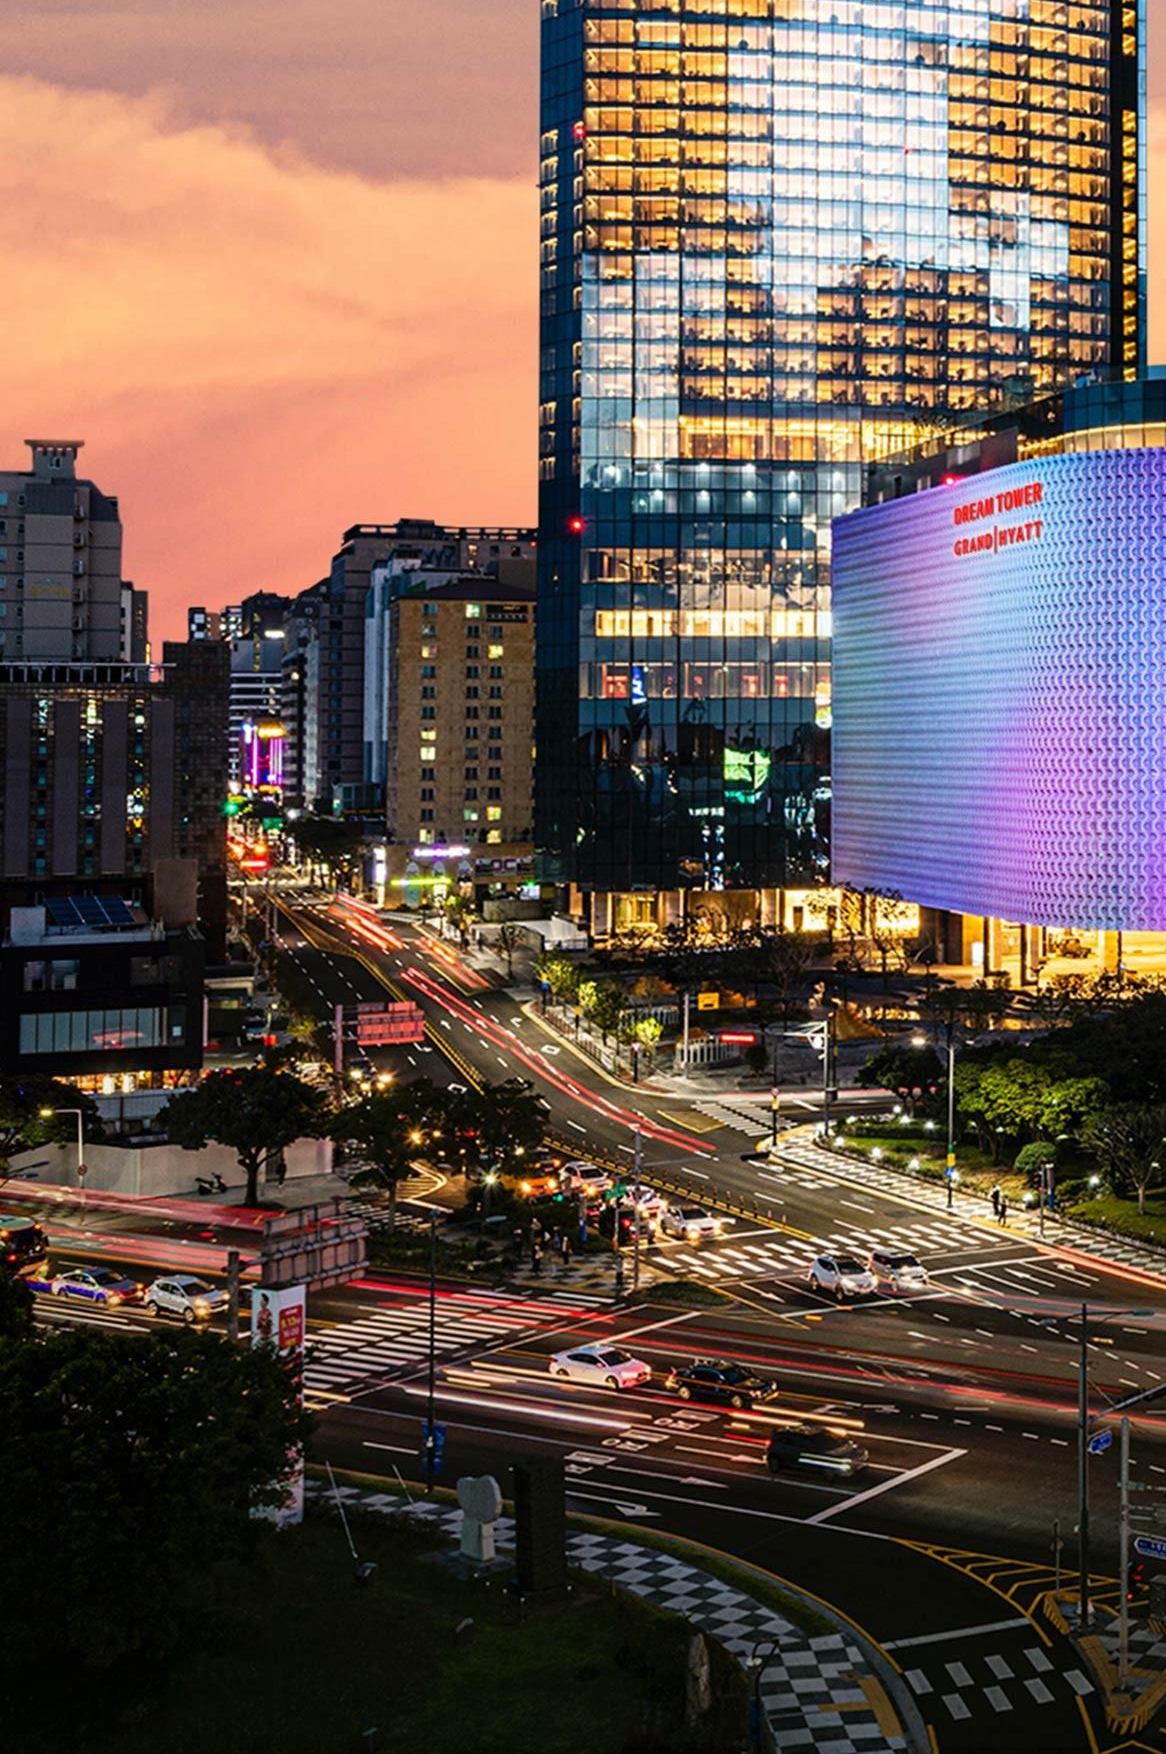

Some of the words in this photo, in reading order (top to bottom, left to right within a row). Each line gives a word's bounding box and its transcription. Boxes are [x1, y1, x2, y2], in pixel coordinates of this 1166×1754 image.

[954, 497, 994, 525] DREAM
[996, 482, 1042, 512] TOWER
[954, 533, 993, 556] GRAND
[999, 520, 1042, 546] HYATT
